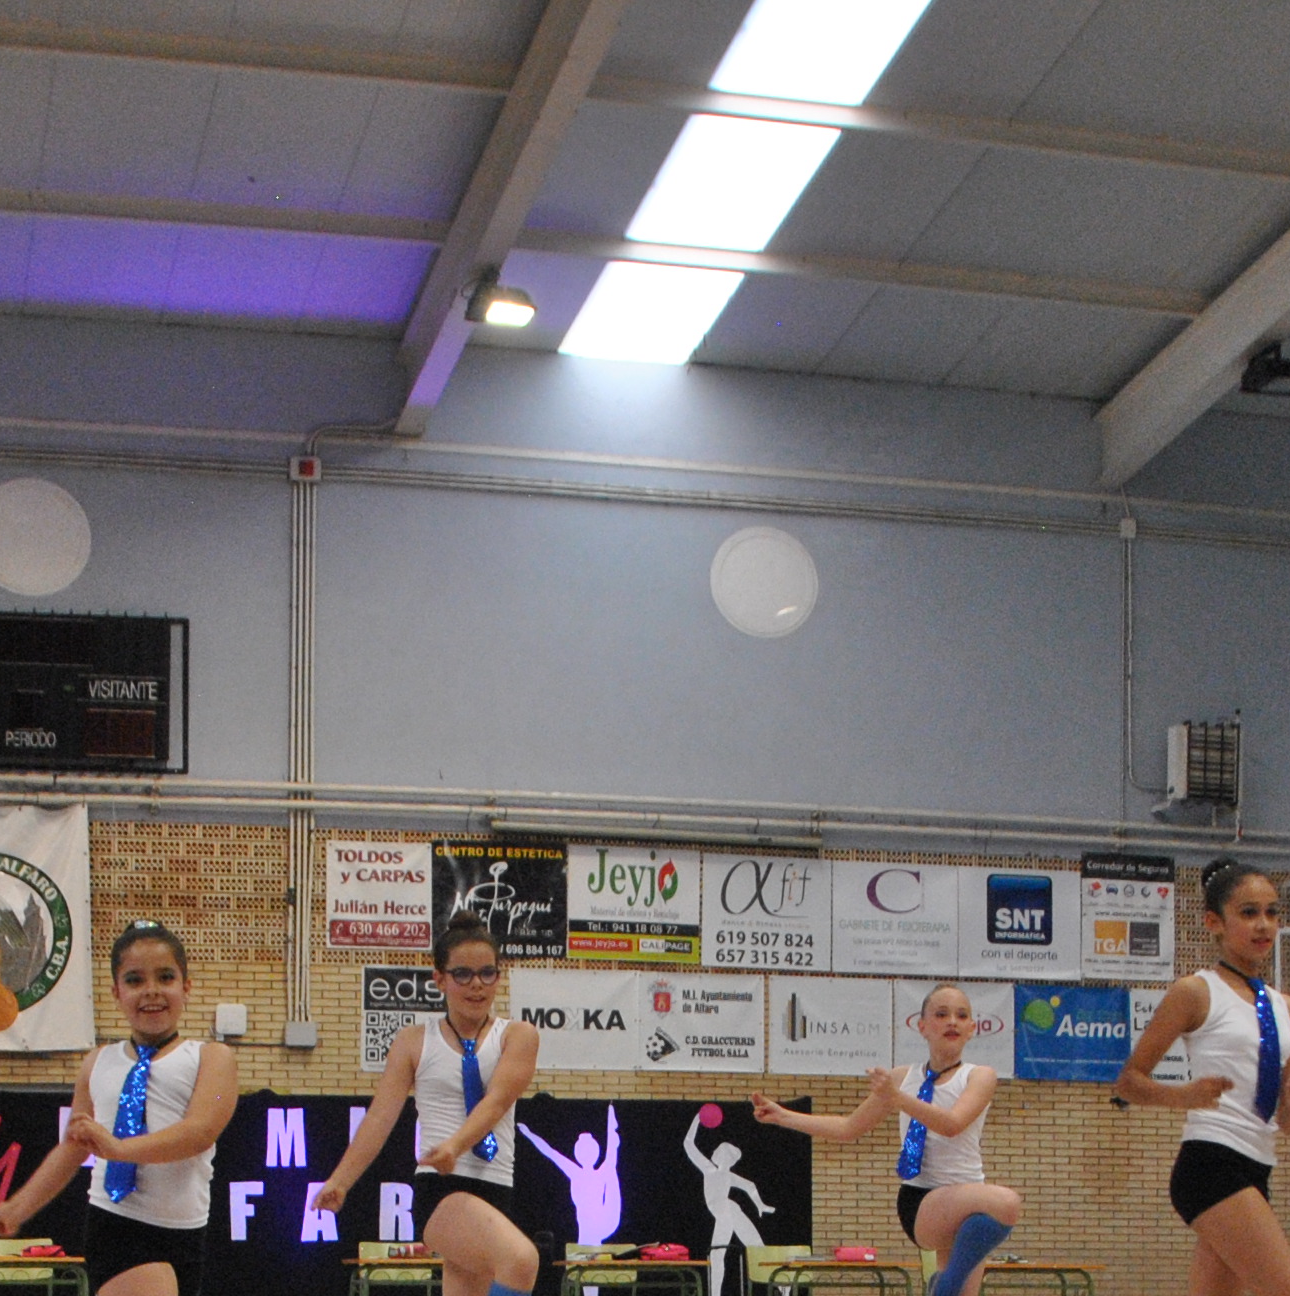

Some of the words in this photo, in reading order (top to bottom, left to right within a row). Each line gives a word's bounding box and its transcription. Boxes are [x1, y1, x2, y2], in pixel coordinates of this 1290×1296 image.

[89, 681, 158, 700] VISITANTE
[335, 849, 403, 864] TOLDOS
[435, 846, 484, 857] CENTRO
[488, 847, 503, 857] DE
[1086, 861, 1124, 871] Corredor
[1126, 863, 1136, 871] de
[1138, 863, 1169, 874] Seguros
[0, 857, 58, 901] ALFARO
[341, 872, 350, 884] y
[356, 868, 425, 883] CARPAS
[866, 868, 921, 914] C
[333, 899, 378, 914] Julián
[384, 901, 426, 915] Herce
[995, 907, 1045, 930] SNT
[349, 922, 372, 935] 630
[376, 923, 399, 935] 466
[404, 924, 426, 937] 202
[612, 923, 631, 932] 941
[635, 923, 647, 932] 18
[650, 924, 663, 933] 08
[716, 931, 746, 944] 619
[750, 932, 780, 946] 507
[784, 934, 813, 947] 824
[1095, 938, 1126, 953] TGA
[715, 949, 745, 963] 657
[750, 950, 779, 964] 315
[784, 952, 813, 966] 422
[981, 950, 1001, 959] con
[1004, 949, 1014, 959] el
[1016, 949, 1058, 961] deporte
[701, 990, 753, 1002] Ayuntamiento
[682, 1003, 692, 1013] de
[695, 1003, 719, 1014] Alfaro
[810, 1022, 850, 1035] INSA
[1056, 1014, 1127, 1038] Aema
[727, 1048, 749, 1058] SALA
